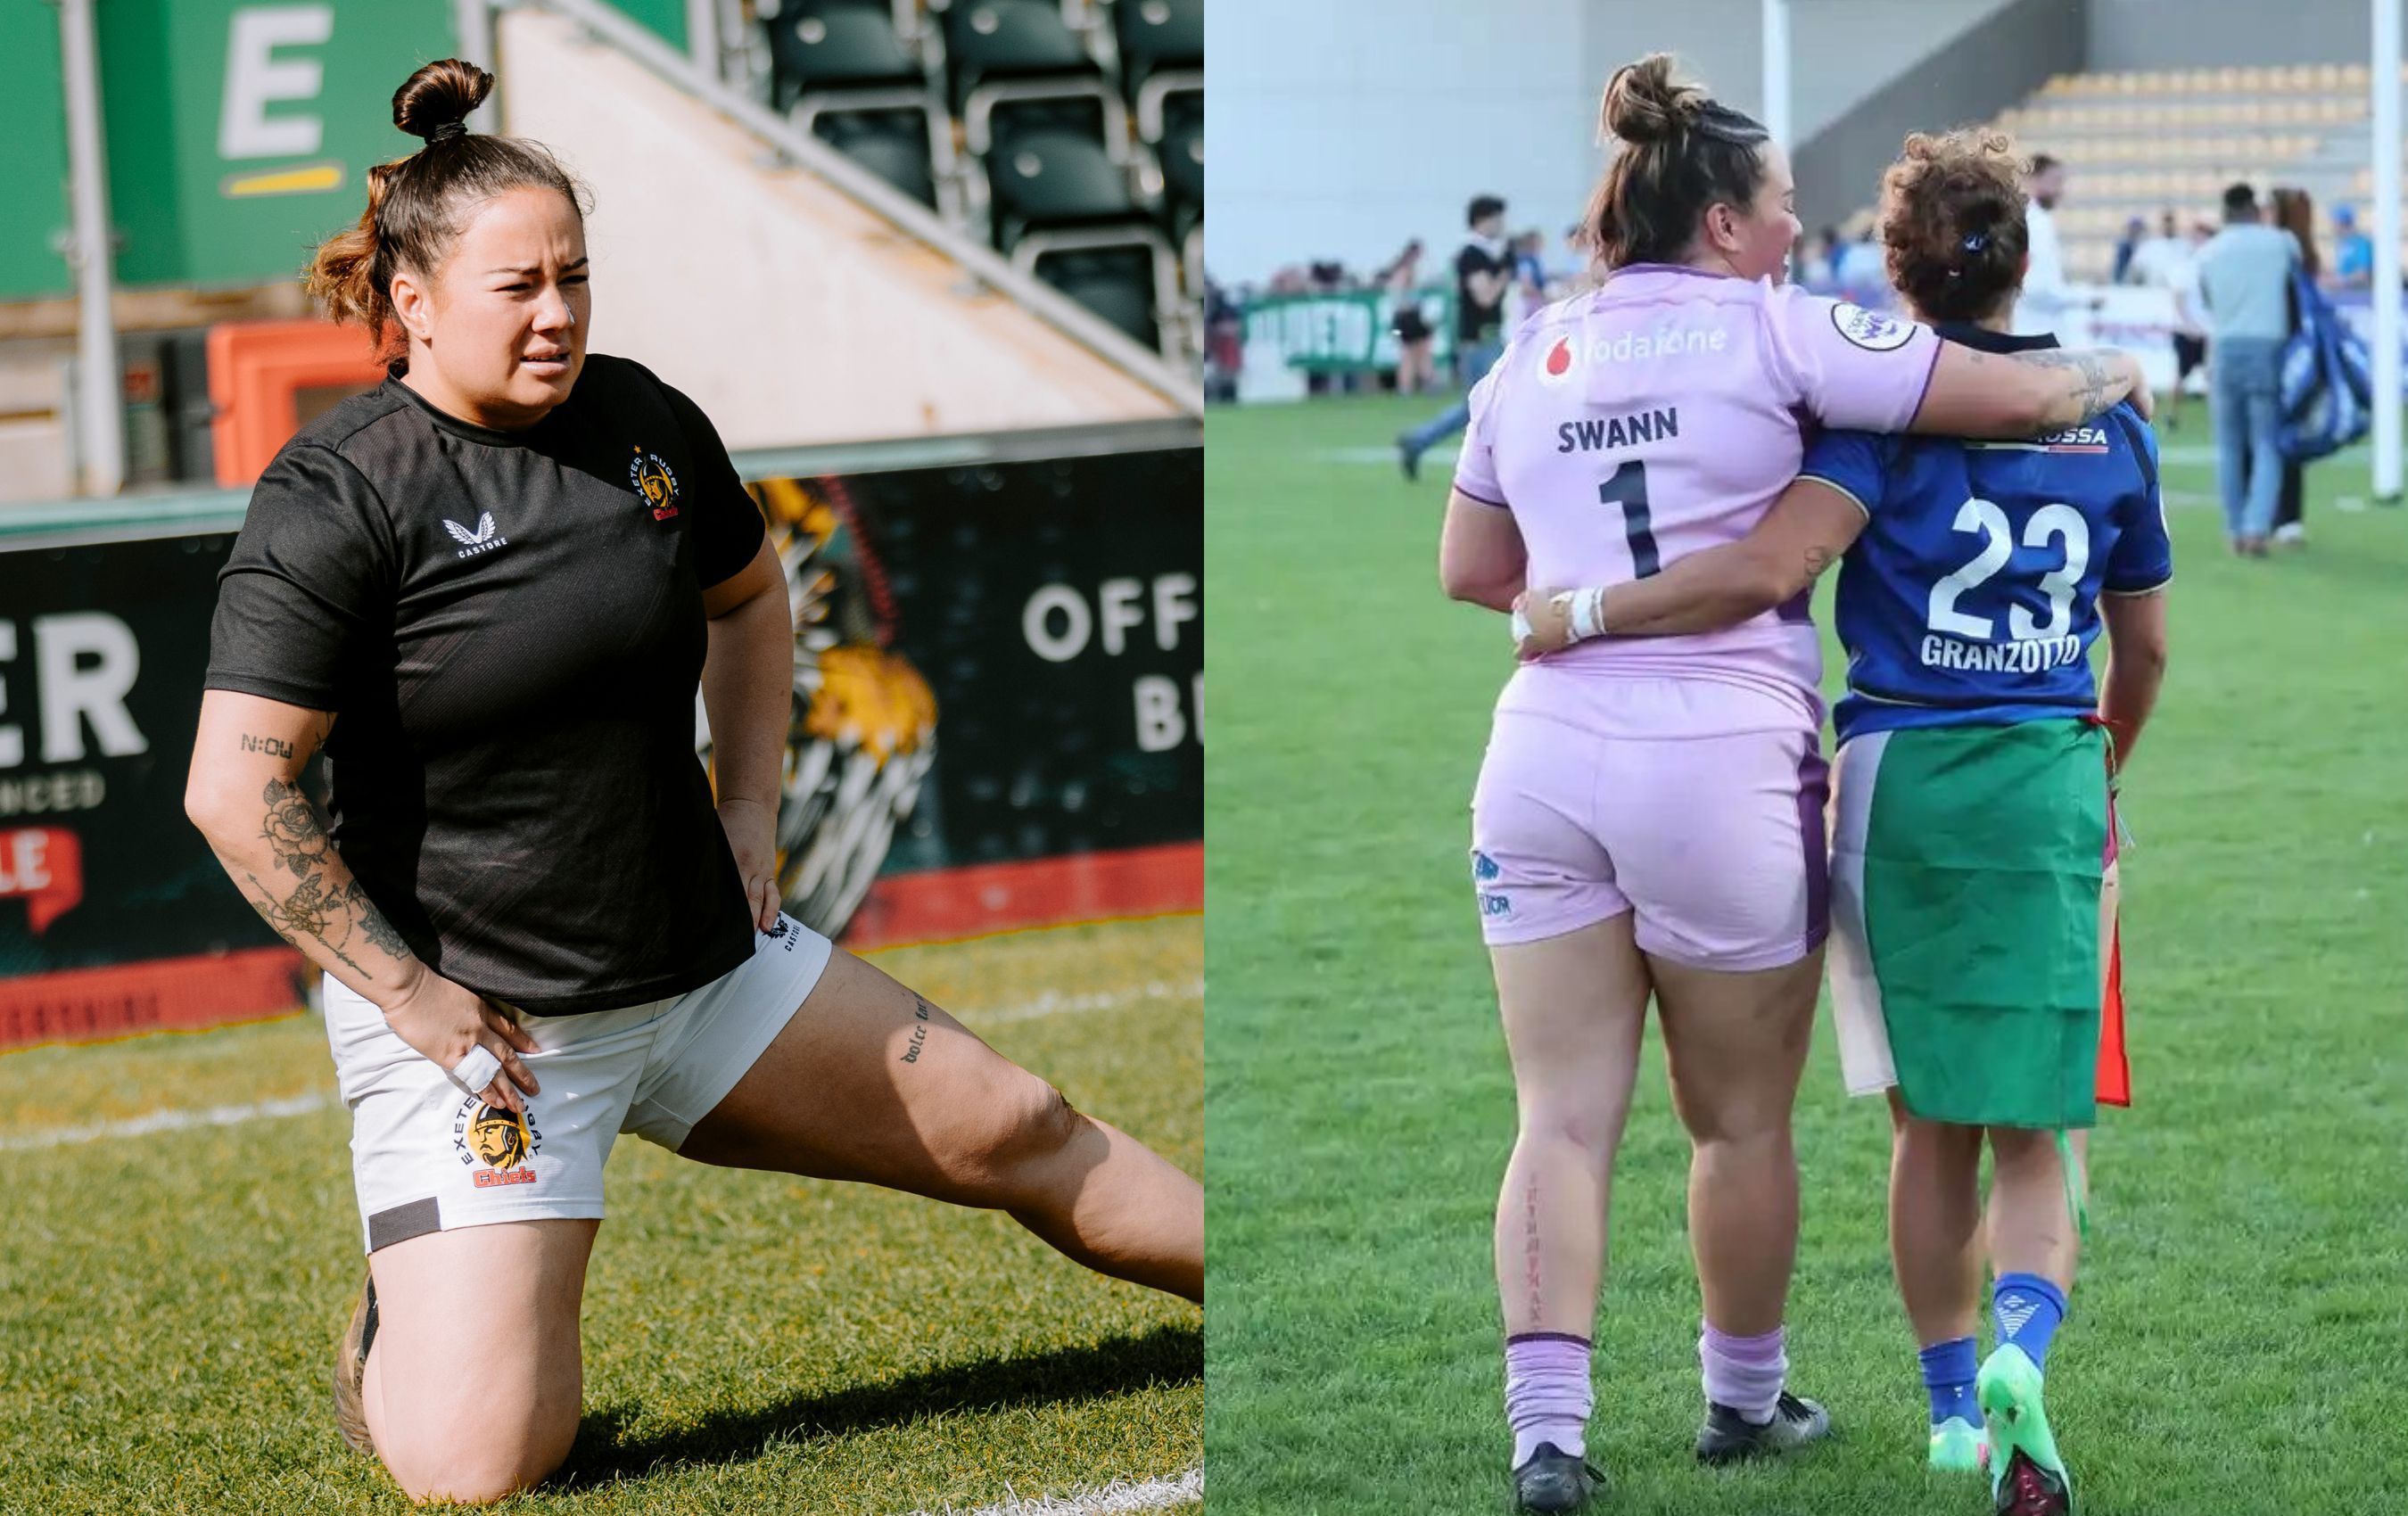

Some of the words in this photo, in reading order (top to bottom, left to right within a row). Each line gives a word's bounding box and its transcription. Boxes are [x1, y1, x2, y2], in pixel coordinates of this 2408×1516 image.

[219, 4, 334, 160] E
[1558, 407, 1678, 453] SWANN
[2039, 427, 2108, 444] OSSA
[458, 537, 507, 558] CASTORE
[1599, 459, 1661, 580] 1
[1927, 497, 2089, 639] 23
[1022, 573, 1198, 663] OFF
[1921, 634, 2081, 673] GRANZOTTO
[0, 610, 150, 768] R
[453, 1093, 482, 1166] EXETE
[473, 1166, 537, 1188] Chiefs
